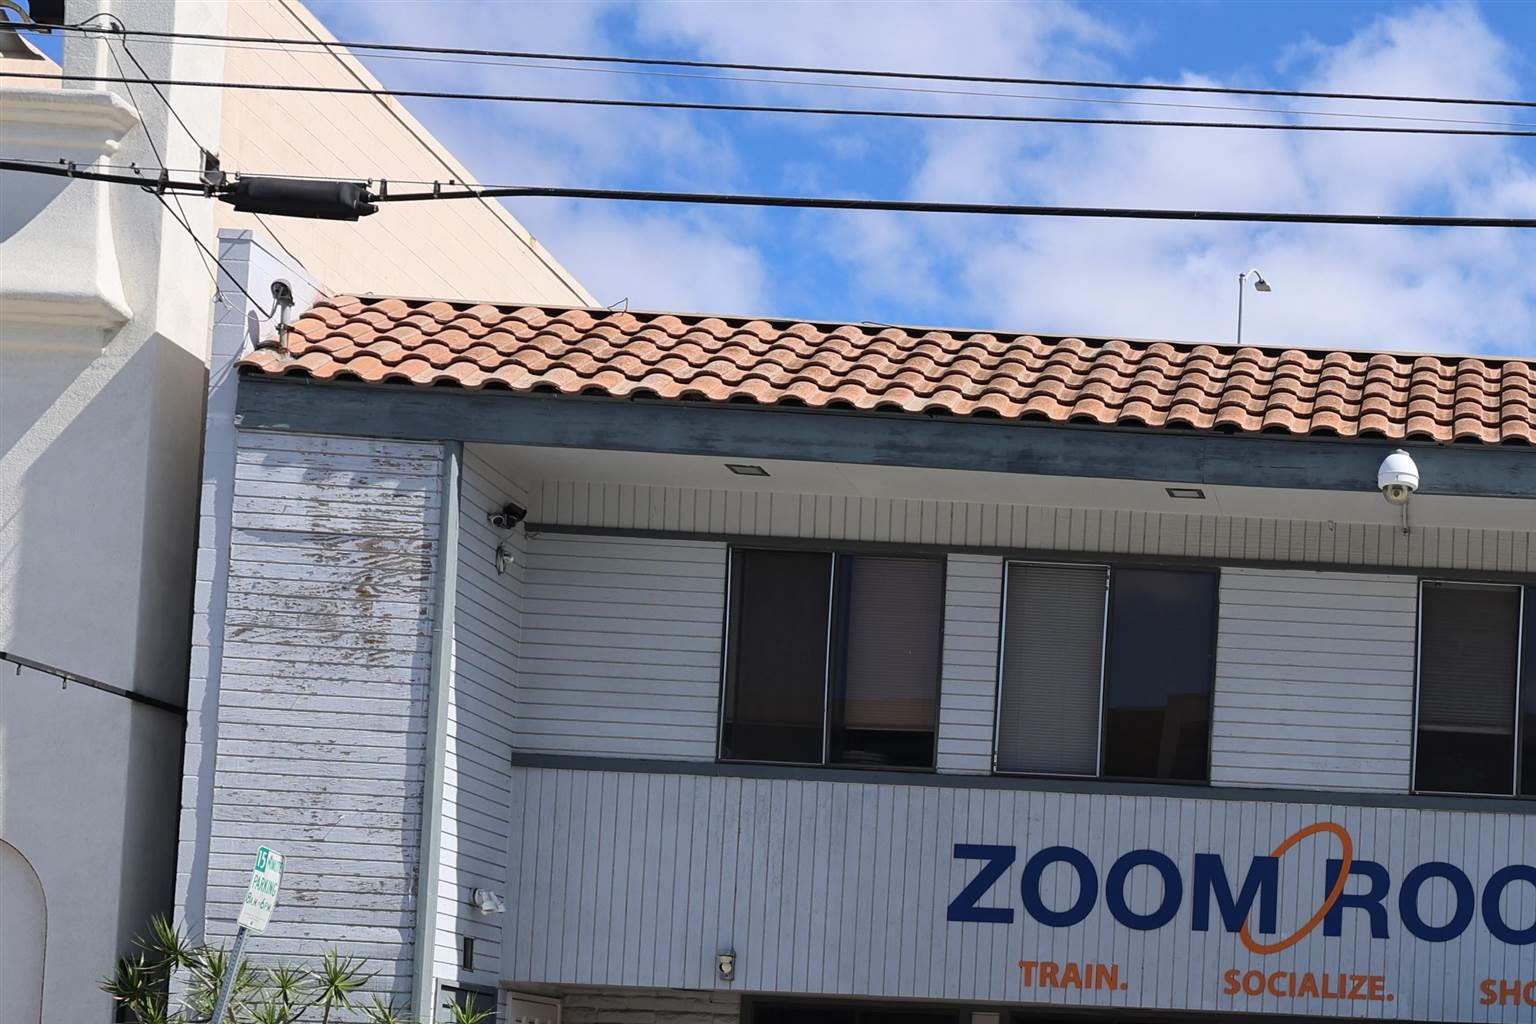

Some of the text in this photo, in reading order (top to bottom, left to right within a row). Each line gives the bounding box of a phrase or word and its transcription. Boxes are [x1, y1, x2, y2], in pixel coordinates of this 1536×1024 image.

[947, 843, 1279, 934] ZOOM
[1018, 961, 1128, 991] TRAIN.
[1223, 969, 1395, 1003] SOCIALIZE.
